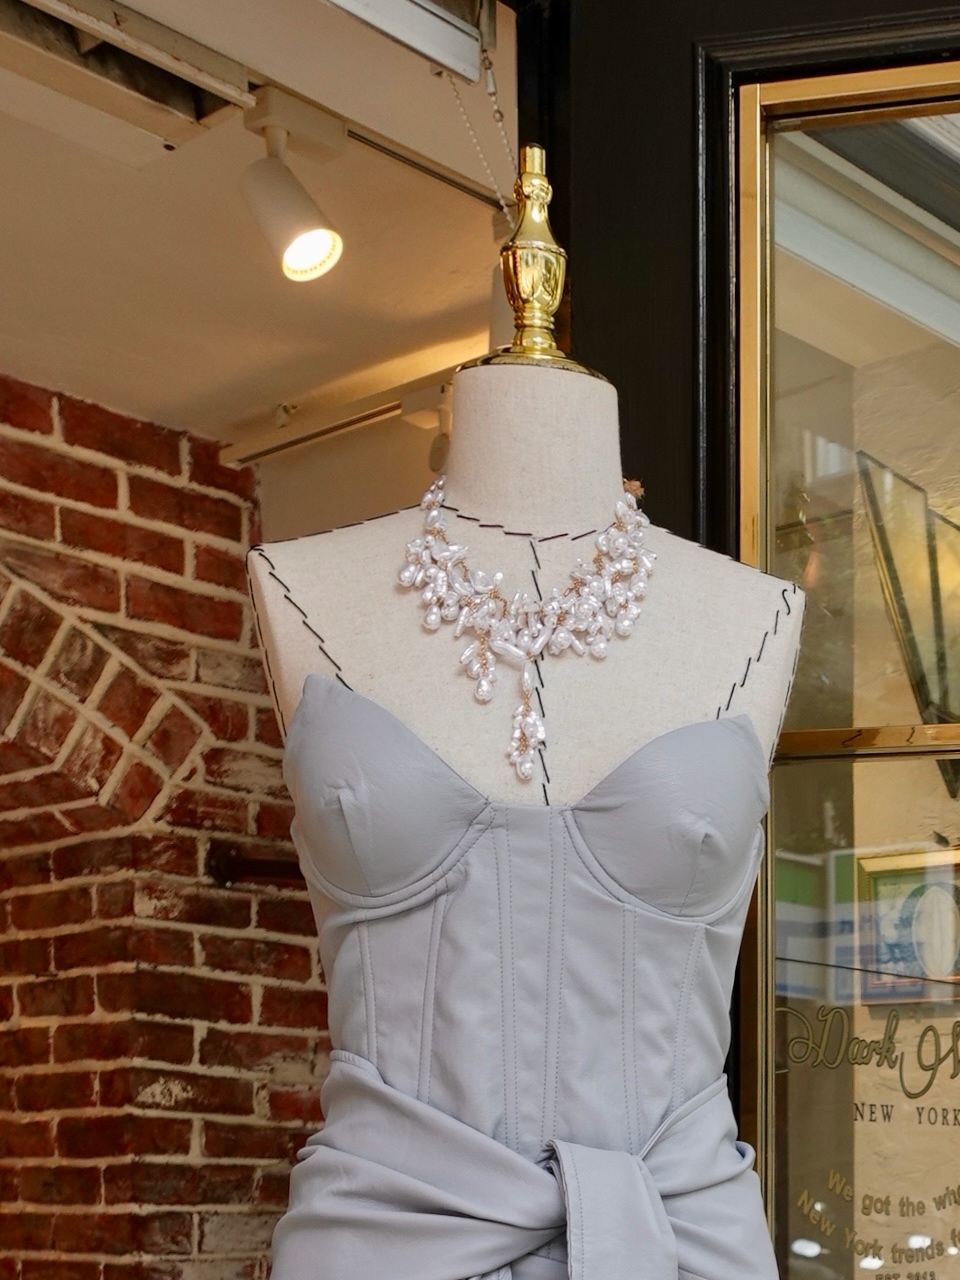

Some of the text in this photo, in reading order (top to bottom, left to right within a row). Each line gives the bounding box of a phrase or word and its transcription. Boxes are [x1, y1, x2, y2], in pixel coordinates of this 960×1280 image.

[776, 1006, 898, 1069] Dark
[854, 1103, 895, 1123] NEW
[826, 1168, 854, 1200] We
[861, 1194, 891, 1216] got
[898, 1196, 926, 1218] the
[797, 1189, 836, 1236] New
[843, 1227, 883, 1260] York
[891, 1239, 945, 1264] trends
